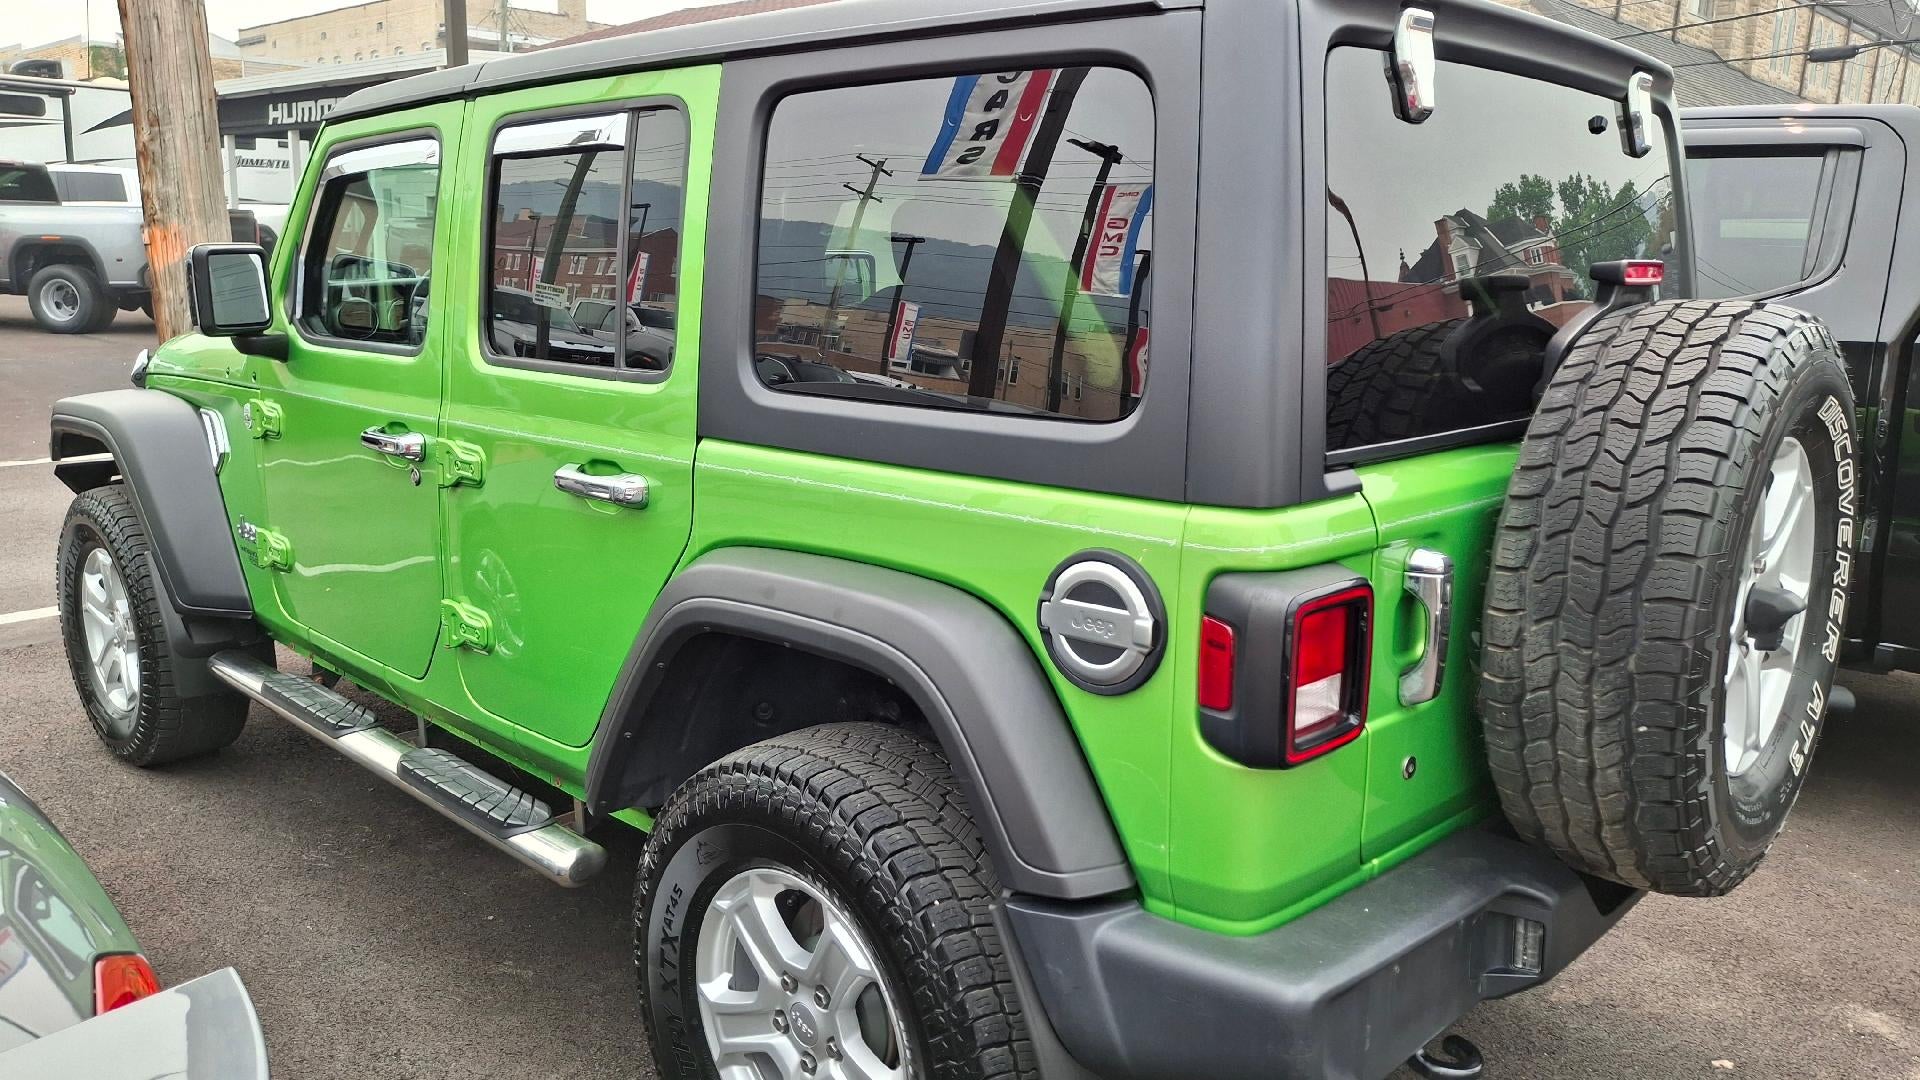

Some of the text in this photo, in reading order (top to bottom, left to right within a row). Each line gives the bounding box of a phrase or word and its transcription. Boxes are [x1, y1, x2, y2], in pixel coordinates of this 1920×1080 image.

[268, 97, 345, 125] HUMM
[1789, 395, 1855, 777] DISCOVERER AT3
[1071, 610, 1116, 640] Jeep
